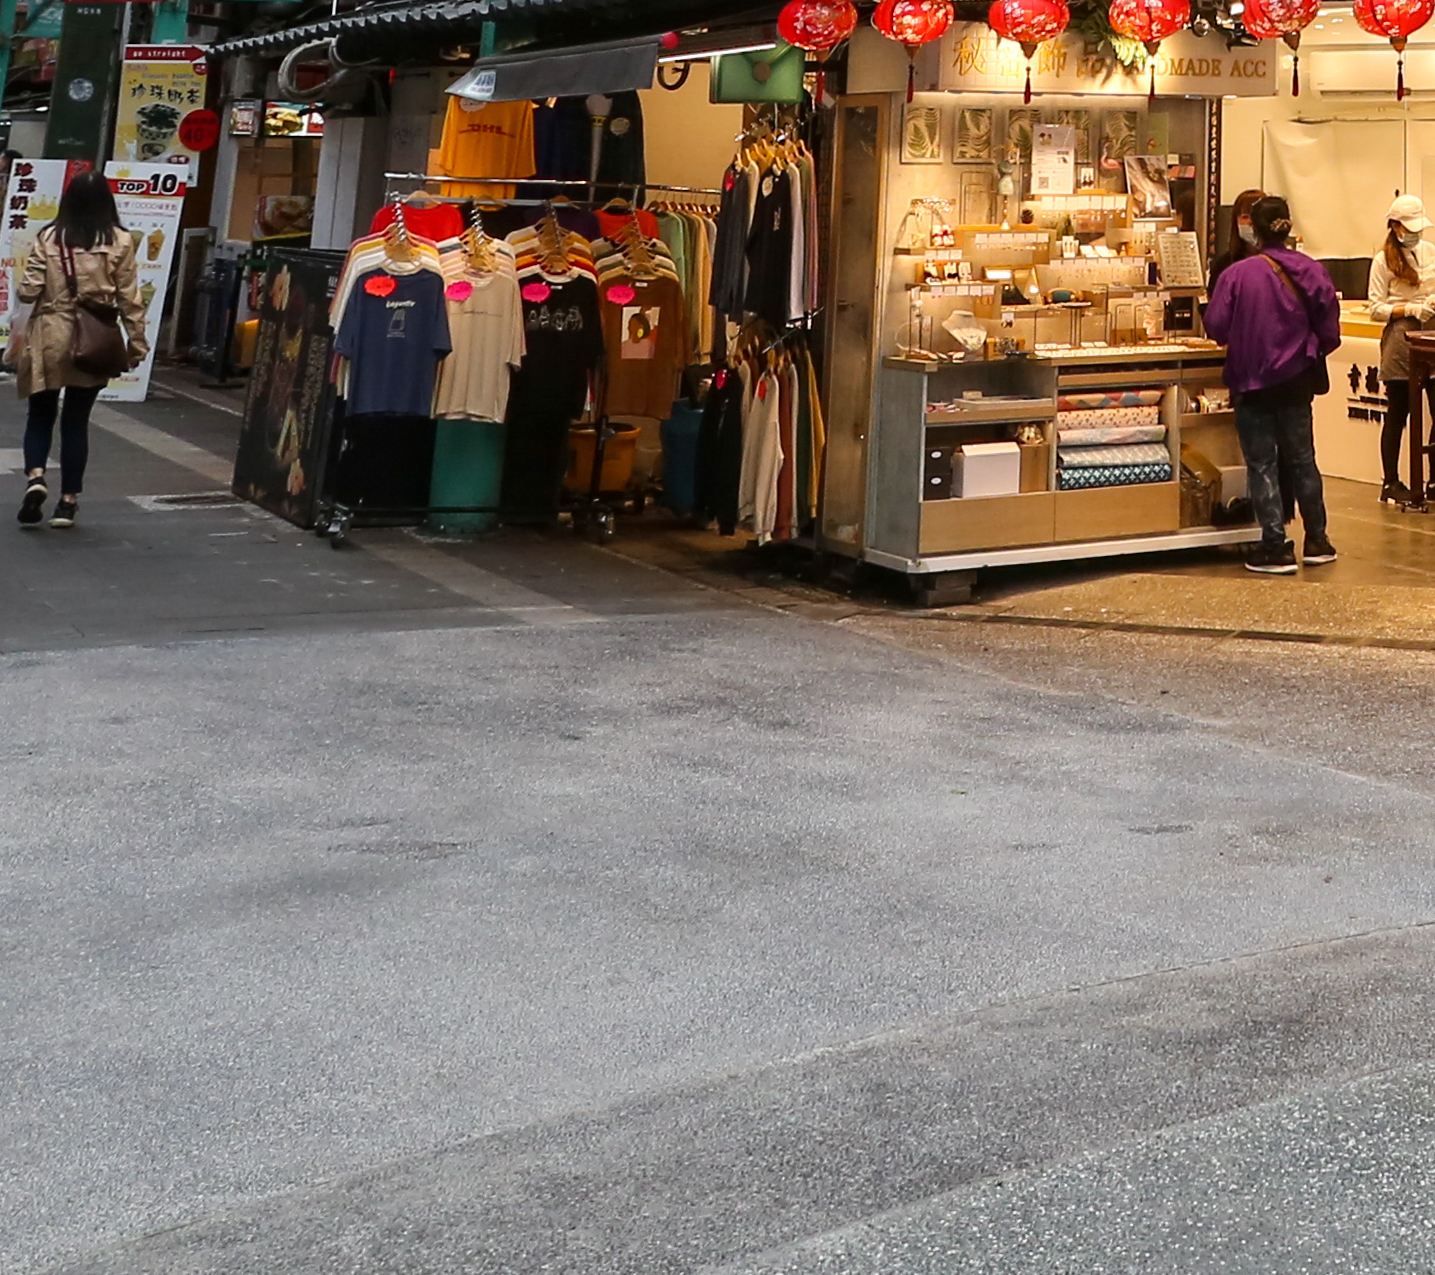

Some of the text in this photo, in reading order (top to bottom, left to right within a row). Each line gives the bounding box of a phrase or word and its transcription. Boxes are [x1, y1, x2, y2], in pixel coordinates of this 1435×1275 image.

[145, 49, 186, 58] straight
[1230, 59, 1266, 78] ACC
[130, 83, 200, 105] 珍珠奶茶
[119, 173, 177, 195] TOP 10
[8, 162, 37, 230] 珍珠奶茶
